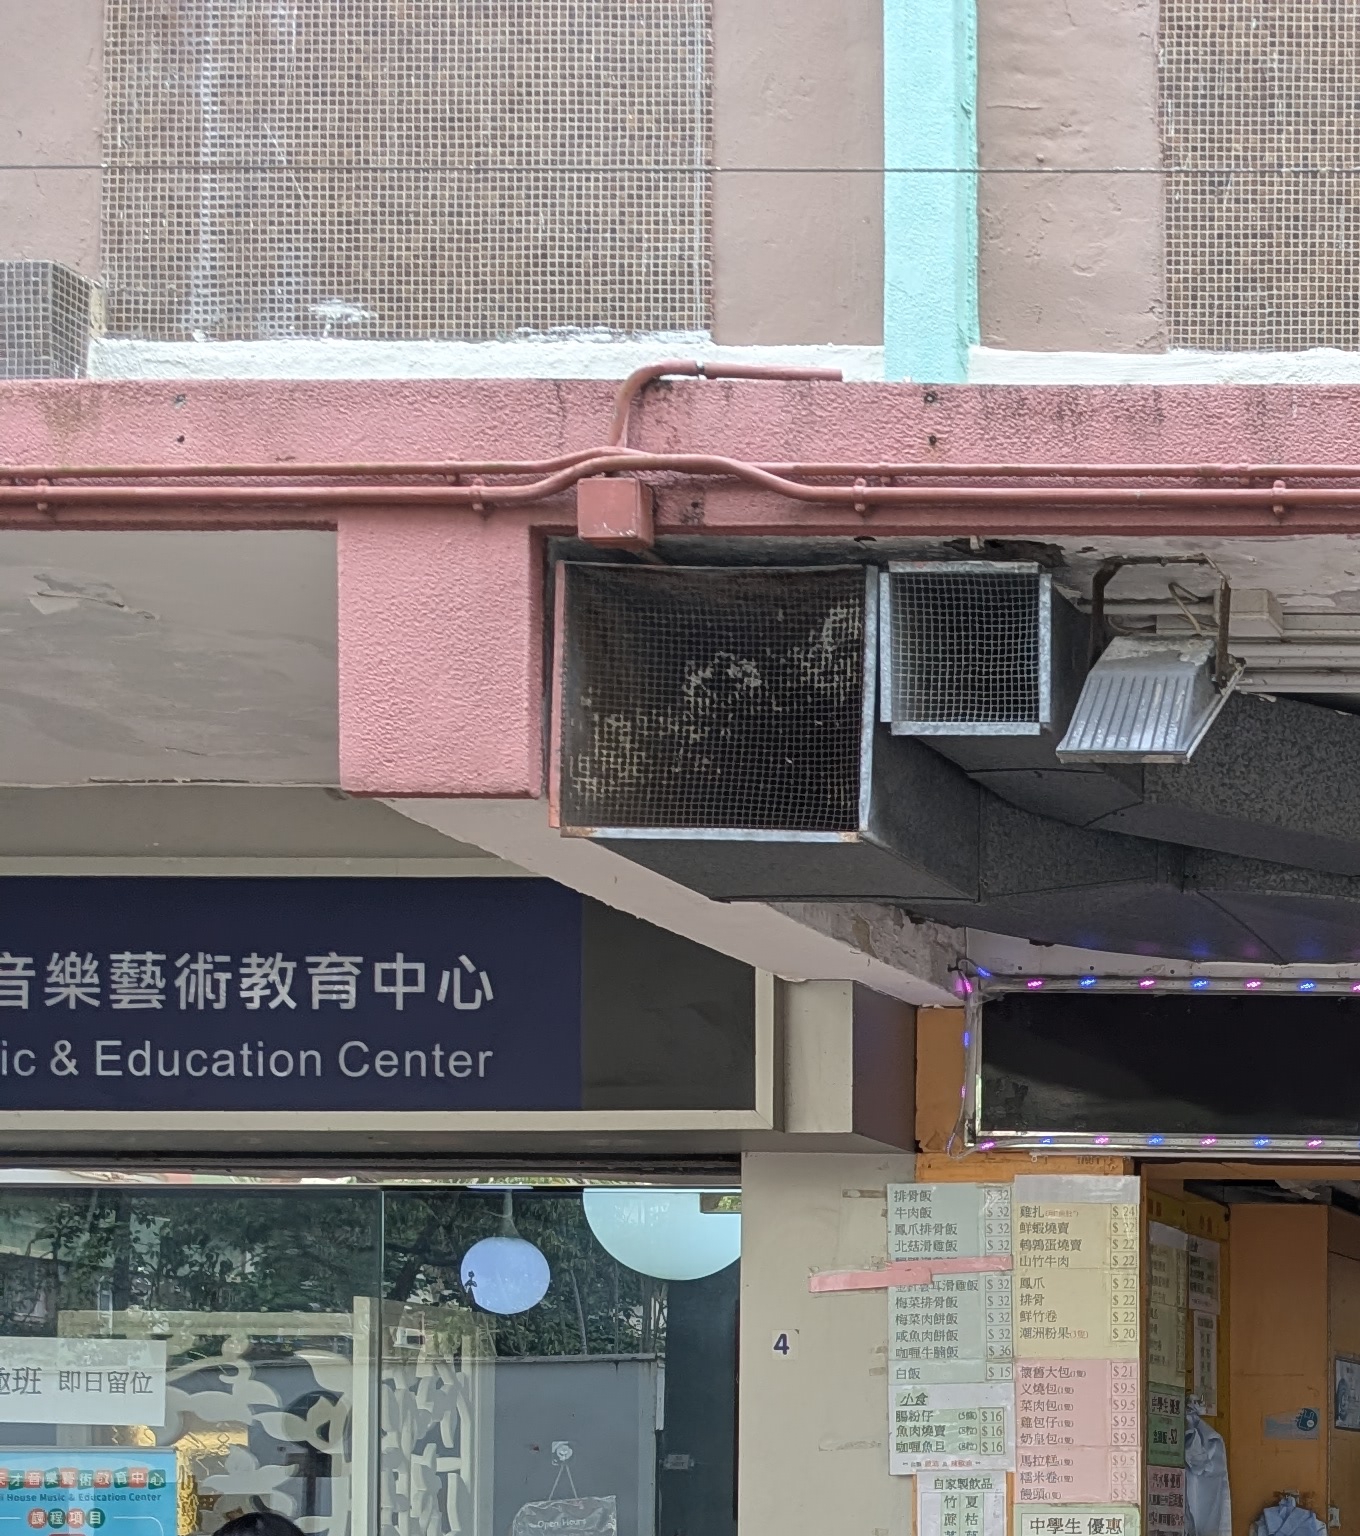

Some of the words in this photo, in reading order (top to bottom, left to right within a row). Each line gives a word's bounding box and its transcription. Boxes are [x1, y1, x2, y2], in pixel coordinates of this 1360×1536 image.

[0, 951, 495, 1010] 音樂藝術教育中心
[49, 1040, 79, 1077] &
[95, 1040, 322, 1077] Education
[337, 1040, 494, 1077] Center
[894, 1190, 932, 1203] 排骨飯
[894, 1206, 932, 1219] 牛肉飯
[1019, 1205, 1045, 1218] 雞扎
[894, 1223, 958, 1236] 鳳爪排骨飯
[1019, 1221, 1070, 1234] 鮮蝦燒賣
[1019, 1238, 1082, 1251] 鵪鶉蛋燒賣
[1019, 1255, 1069, 1268] 山竹牛肉
[1019, 1277, 1046, 1290] 鳳爪
[895, 1297, 959, 1309] 梅菜排骨飯
[1019, 1293, 1045, 1306] 排骨
[895, 1313, 959, 1326] 梅菜肉餅飯
[773, 1334, 790, 1356] 4
[896, 1367, 921, 1379] 白飯
[1113, 1365, 1133, 1378] $21
[59, 1370, 153, 1394] 即日留位
[1113, 1382, 1136, 1394] $9.5
[900, 1392, 929, 1406] 小食
[1113, 1399, 1136, 1411] $9.5
[896, 1410, 934, 1423] 腸粉仔
[1113, 1415, 1136, 1427] $9.5
[896, 1425, 946, 1438] 魚肉燒賣
[1113, 1432, 1136, 1444] $9.5
[934, 1477, 993, 1490] 自家製飲品
[78, 1492, 127, 1502] Education
[128, 1492, 162, 1502] Center
[30, 1511, 102, 1526] 課程項目
[1030, 1517, 1082, 1535] 中學生
[1087, 1517, 1123, 1535] 優惠
